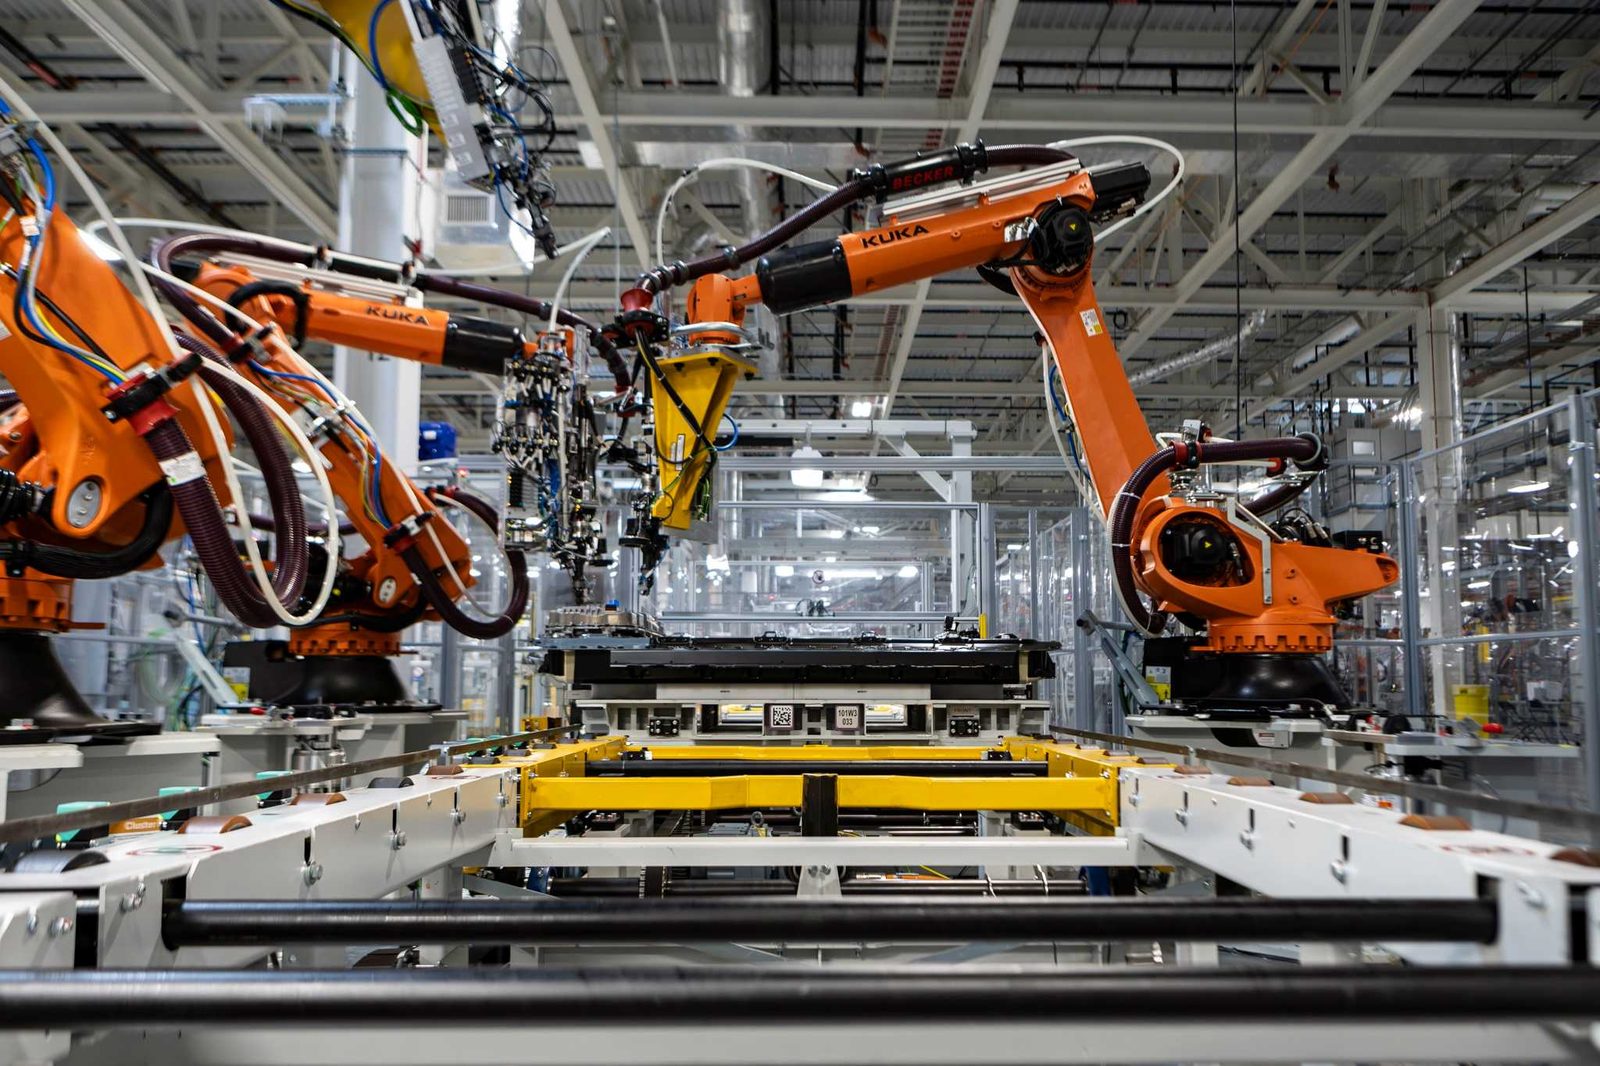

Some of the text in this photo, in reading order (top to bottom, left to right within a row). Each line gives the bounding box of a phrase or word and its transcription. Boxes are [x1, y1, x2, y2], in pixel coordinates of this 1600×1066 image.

[892, 165, 954, 190] BECKER
[861, 224, 929, 248] KUKA
[366, 306, 429, 326] KUKA
[838, 709, 857, 717] 101W3
[842, 718, 853, 726] 033
